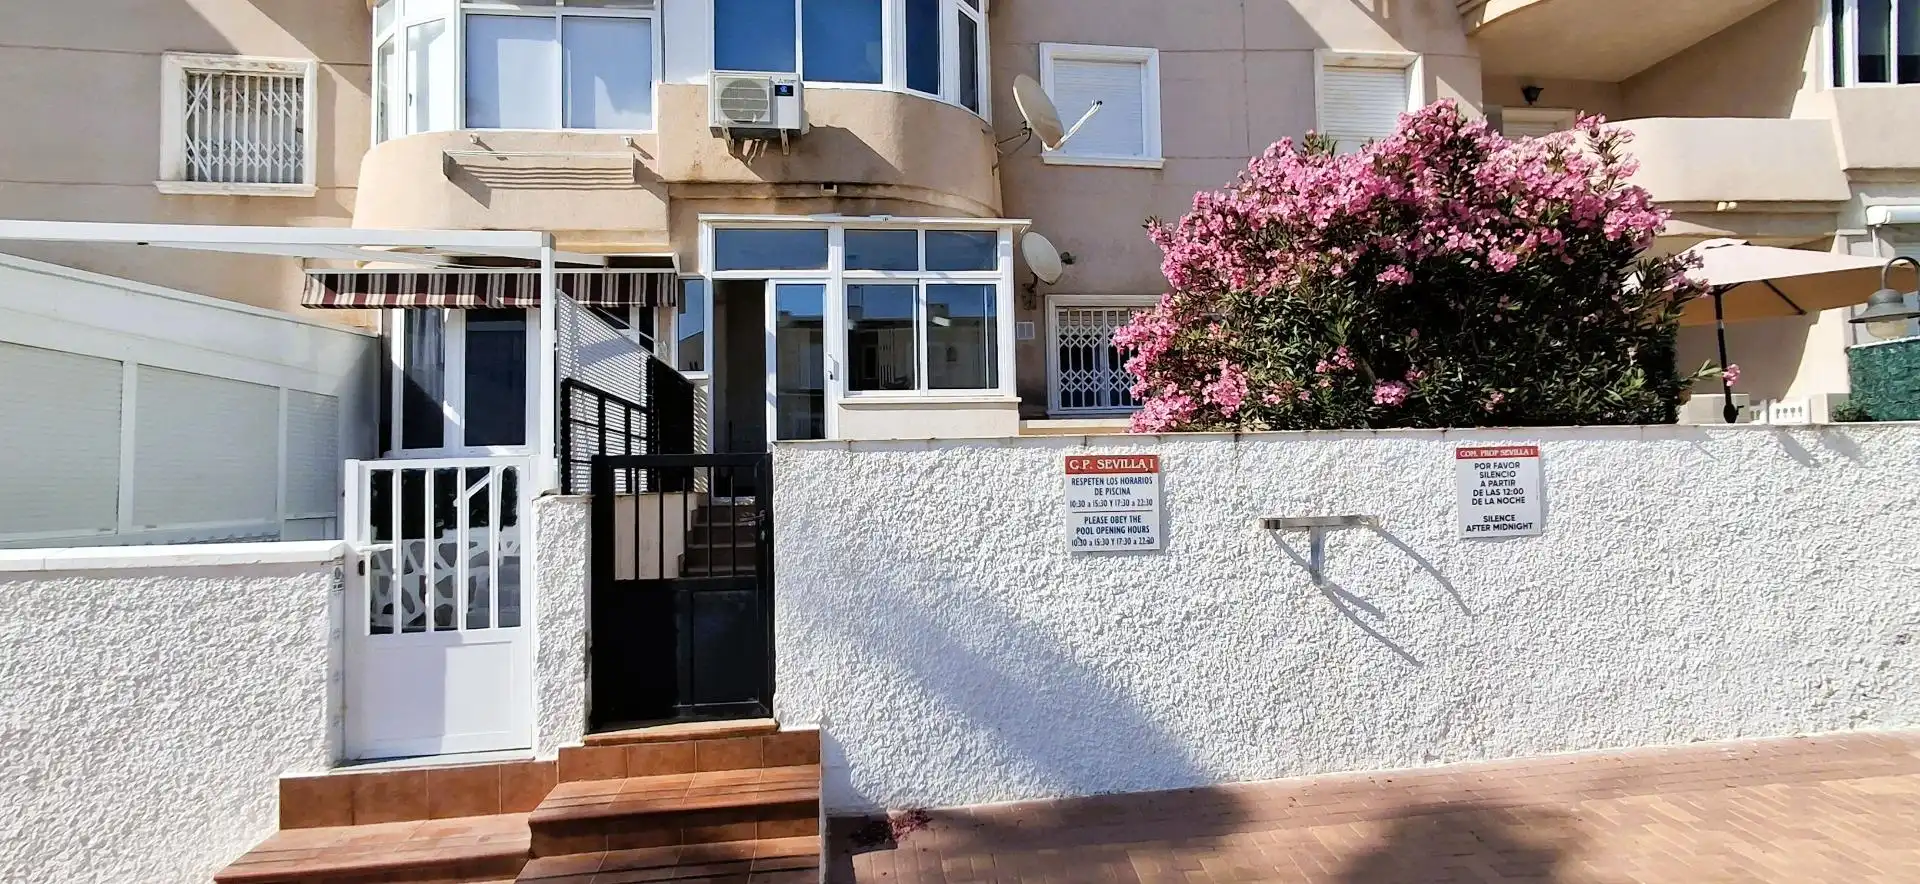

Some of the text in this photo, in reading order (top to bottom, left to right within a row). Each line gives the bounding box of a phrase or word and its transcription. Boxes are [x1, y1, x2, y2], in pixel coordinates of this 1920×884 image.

[1097, 459, 1146, 469] SEVILLA
[1107, 477, 1118, 485] LOS
[1085, 516, 1108, 524] PLEASE
[1130, 515, 1141, 523] THE
[1076, 527, 1094, 535] POOL
[1096, 526, 1125, 534] OPENING
[1493, 523, 1533, 531] MIDNIGHT
[1117, 537, 1131, 545] 17:30
